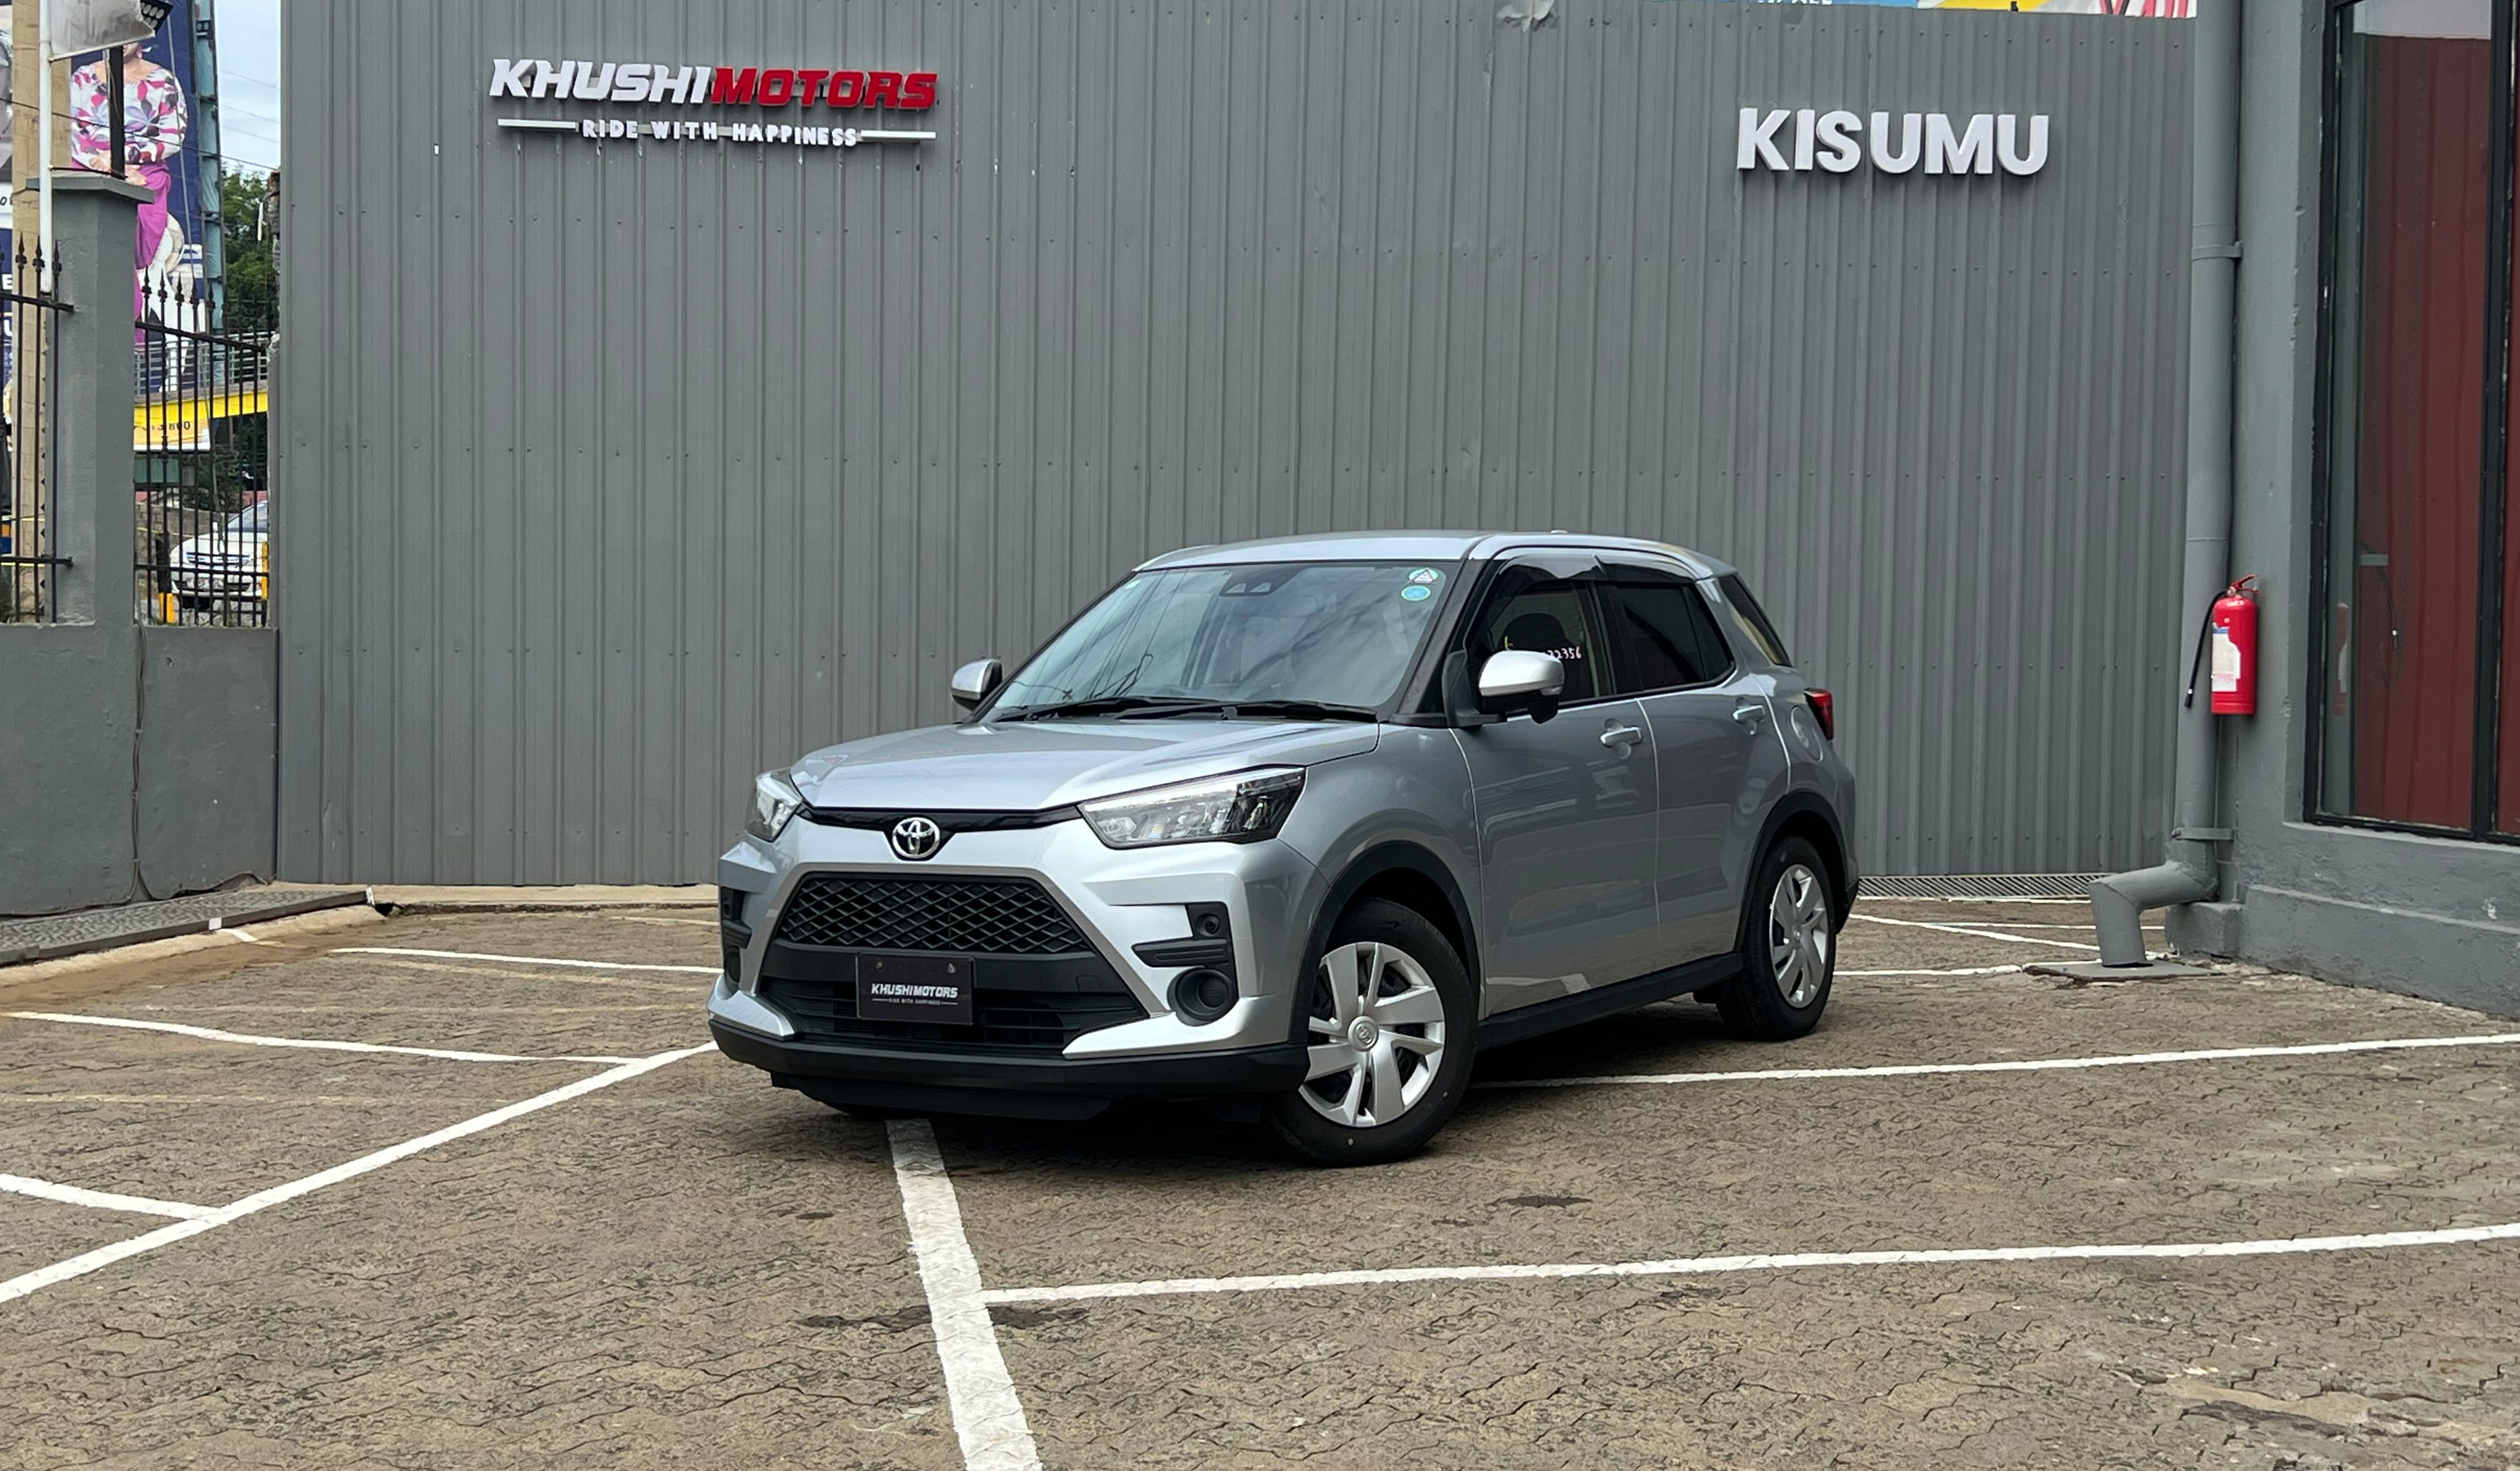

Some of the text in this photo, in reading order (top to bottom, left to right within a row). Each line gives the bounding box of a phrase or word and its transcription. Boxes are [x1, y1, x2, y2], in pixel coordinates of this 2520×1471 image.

[582, 119, 858, 147] RIDE WITH HAPPINESS
[1737, 107, 2049, 176] KISUMU
